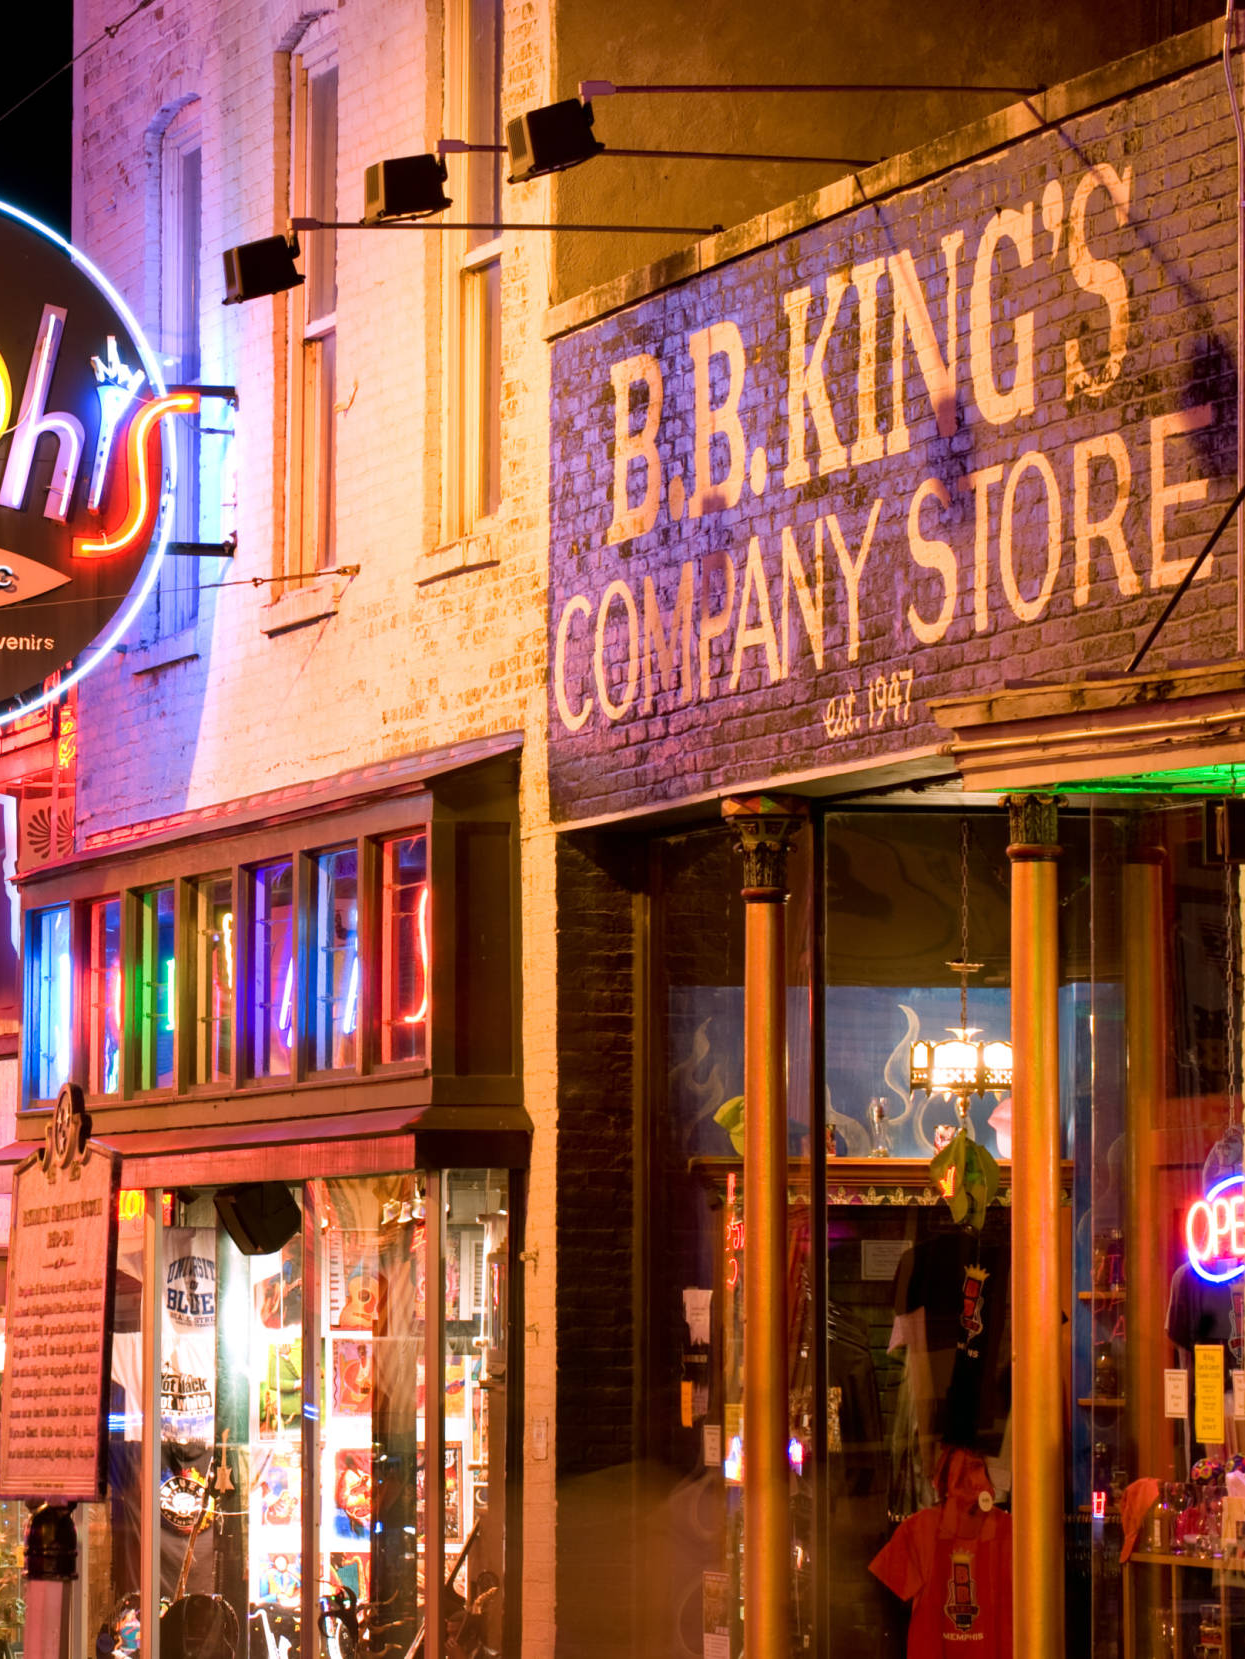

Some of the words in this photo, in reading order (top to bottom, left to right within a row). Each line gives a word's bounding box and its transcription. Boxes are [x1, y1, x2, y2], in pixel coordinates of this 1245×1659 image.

[783, 162, 1134, 489] KING'S
[554, 499, 882, 731] COMPANY
[908, 405, 1213, 645] STORE
[822, 686, 860, 738] est.
[868, 668, 914, 729] 1947
[167, 1256, 215, 1283] UNIVERSIT
[167, 1288, 214, 1315] BLUE
